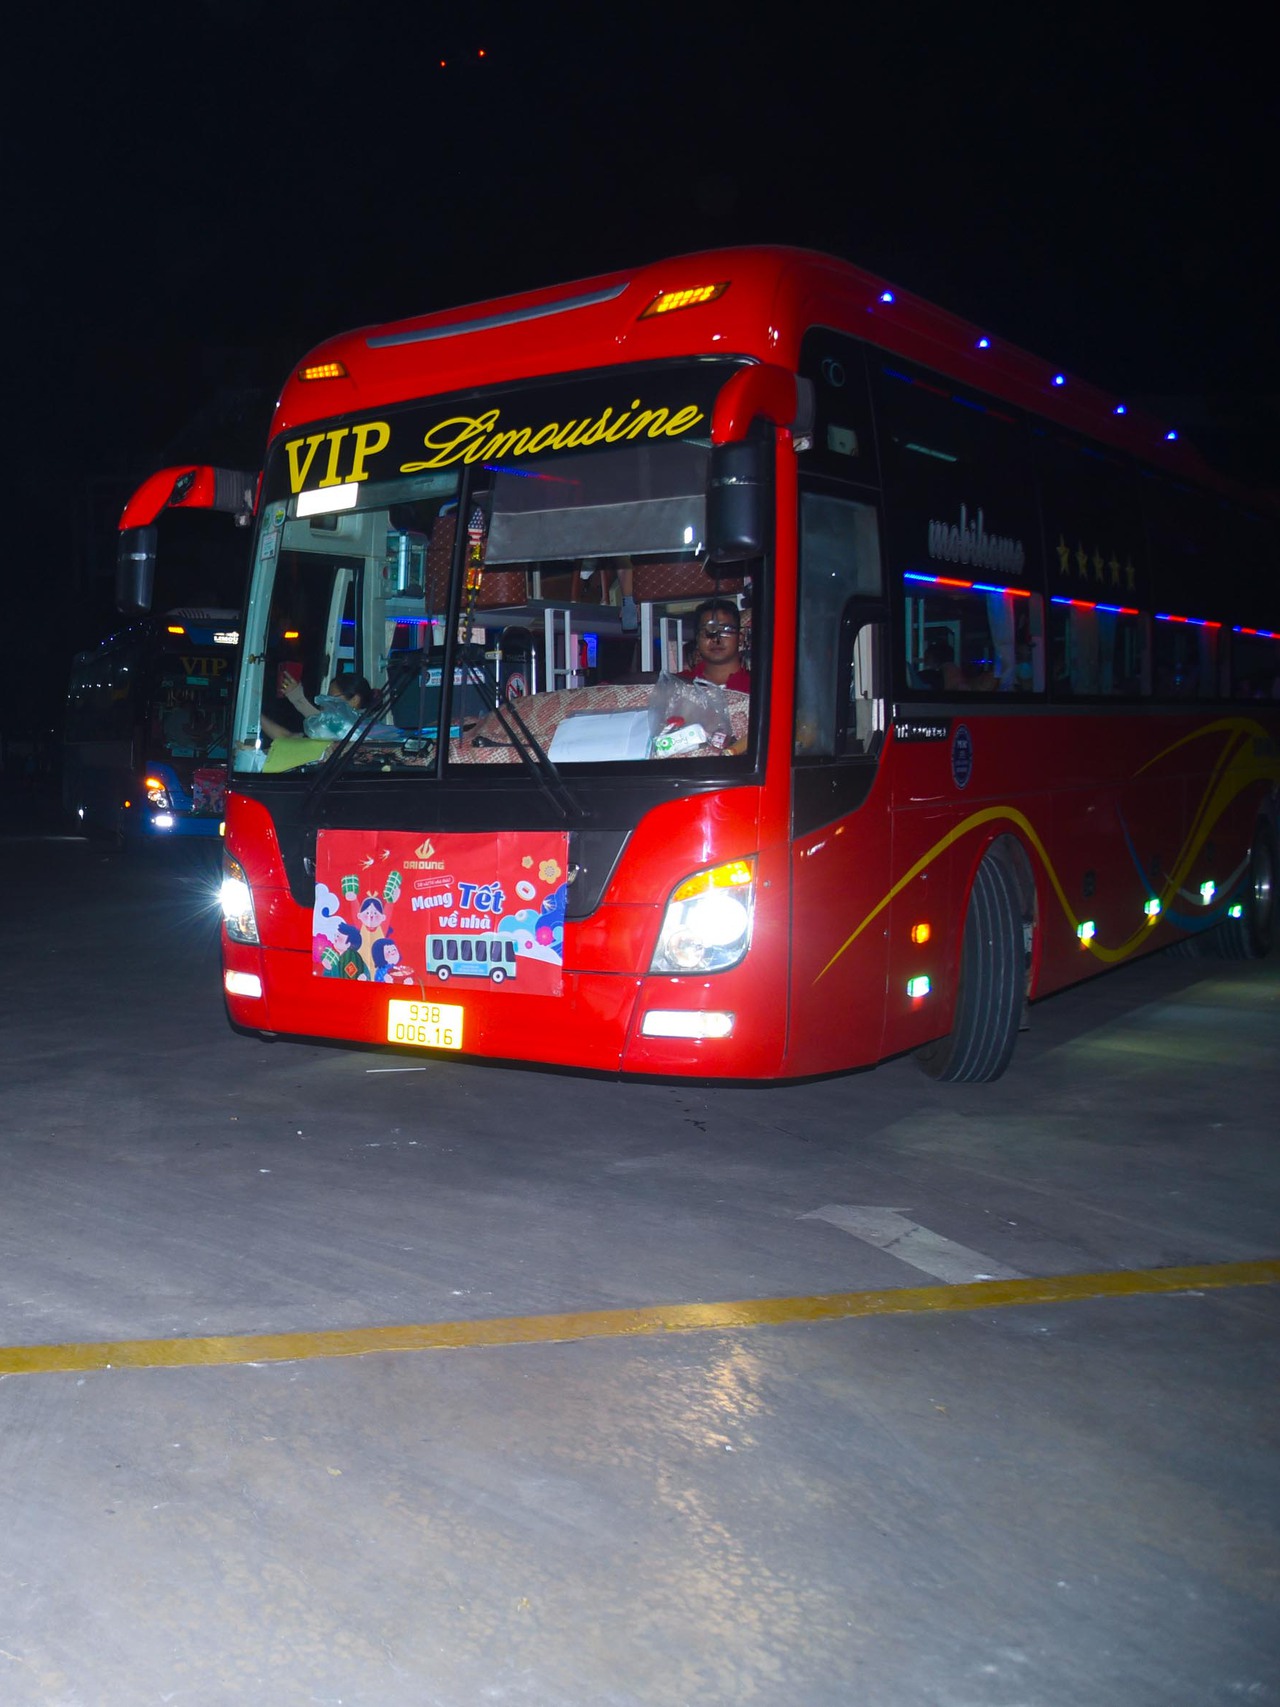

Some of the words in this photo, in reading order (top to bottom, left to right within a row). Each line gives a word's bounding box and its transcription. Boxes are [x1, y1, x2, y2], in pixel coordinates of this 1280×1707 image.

[285, 420, 391, 494] VIP
[399, 398, 705, 474] Limousine
[179, 655, 228, 676] VIP
[411, 892, 453, 912] Mang
[457, 881, 506, 914] Tết
[438, 910, 459, 928] về
[460, 914, 491, 930] nhà
[409, 1004, 441, 1024] 93B
[395, 1023, 454, 1046] 006.16
